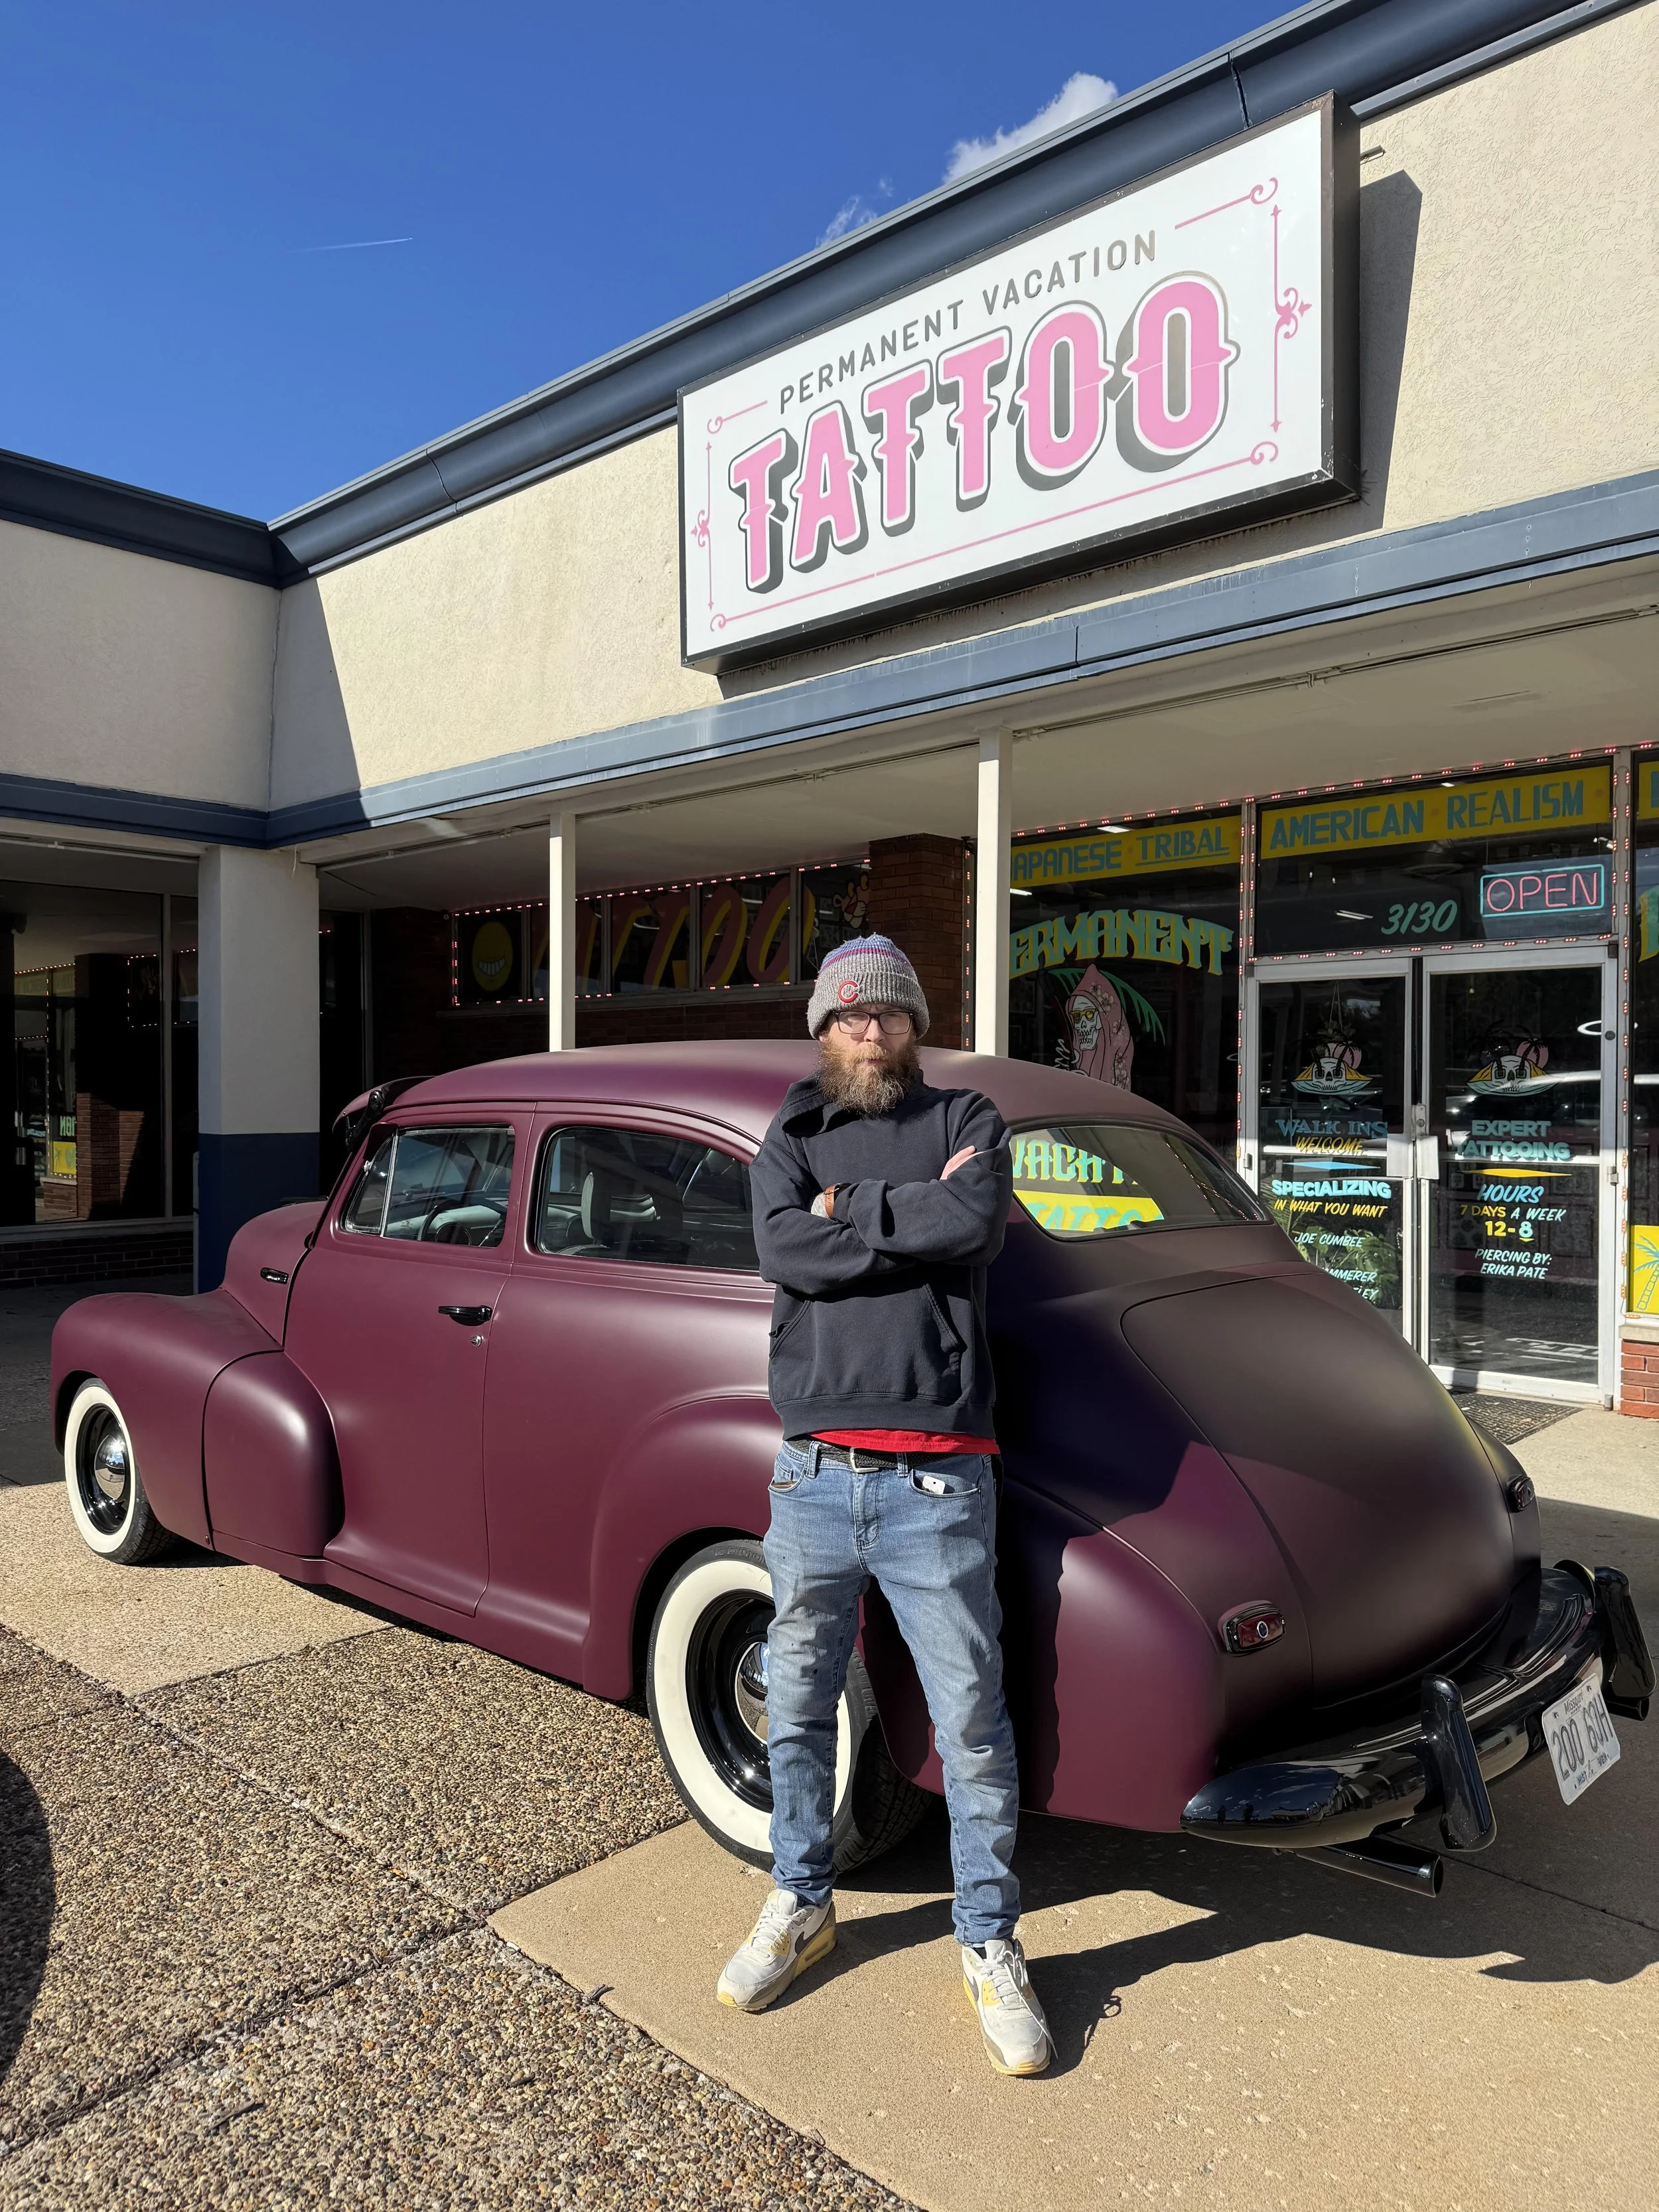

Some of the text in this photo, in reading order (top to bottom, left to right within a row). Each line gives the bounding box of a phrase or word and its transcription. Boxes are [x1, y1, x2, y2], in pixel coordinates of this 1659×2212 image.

[780, 230, 1157, 415] PERMANENT VACATION
[728, 269, 1241, 594] TATTOO
[1269, 780, 1584, 849] AMERICAN REALISM
[1011, 826, 1230, 881] APANESE TRIBAL
[1486, 871, 1598, 912] OPEN
[1381, 899, 1457, 935] 3130
[1009, 909, 1234, 980] ERMANENT
[837, 980, 859, 1003] C
[1275, 1119, 1388, 1139] WALK INS
[1472, 1120, 1552, 1137] EXPERT
[1295, 1136, 1364, 1153] WELCOME
[1457, 1140, 1573, 1161] TATTOOING
[1271, 1179, 1392, 1199] SPECIALIZING
[1477, 1183, 1545, 1203] HOURS
[1274, 1199, 1388, 1218] IN WHAT YOU WANT
[1461, 1205, 1567, 1222] 7 DAYS A WEEK
[1294, 1232, 1366, 1248] JOE CUMBEE
[1475, 1248, 1552, 1265] PIERCING BY:
[1480, 1263, 1549, 1280] ERIKA PATE
[1564, 1689, 1583, 1714] Missouri
